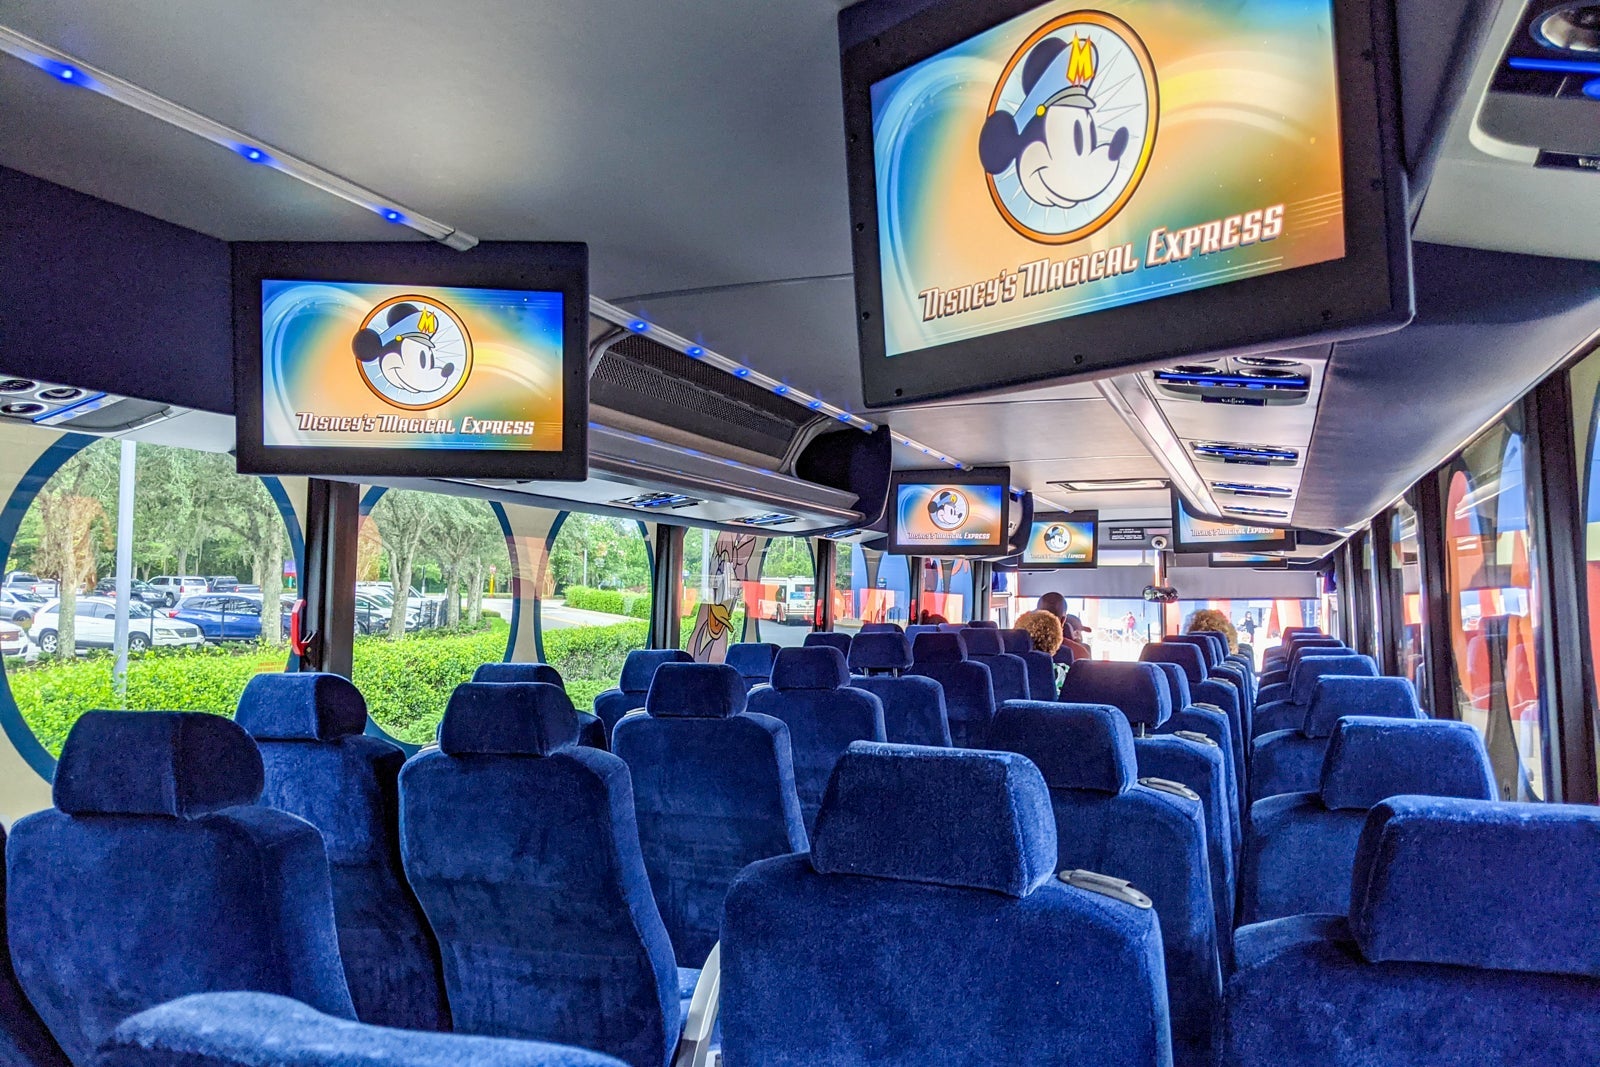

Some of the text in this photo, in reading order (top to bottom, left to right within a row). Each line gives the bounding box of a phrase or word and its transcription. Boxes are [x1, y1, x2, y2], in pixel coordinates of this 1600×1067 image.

[1018, 243, 1139, 298] MAGICAL
[1145, 203, 1285, 268] EXPRESS
[376, 414, 456, 433] MAGICAL
[460, 416, 535, 436] EXPRESS
